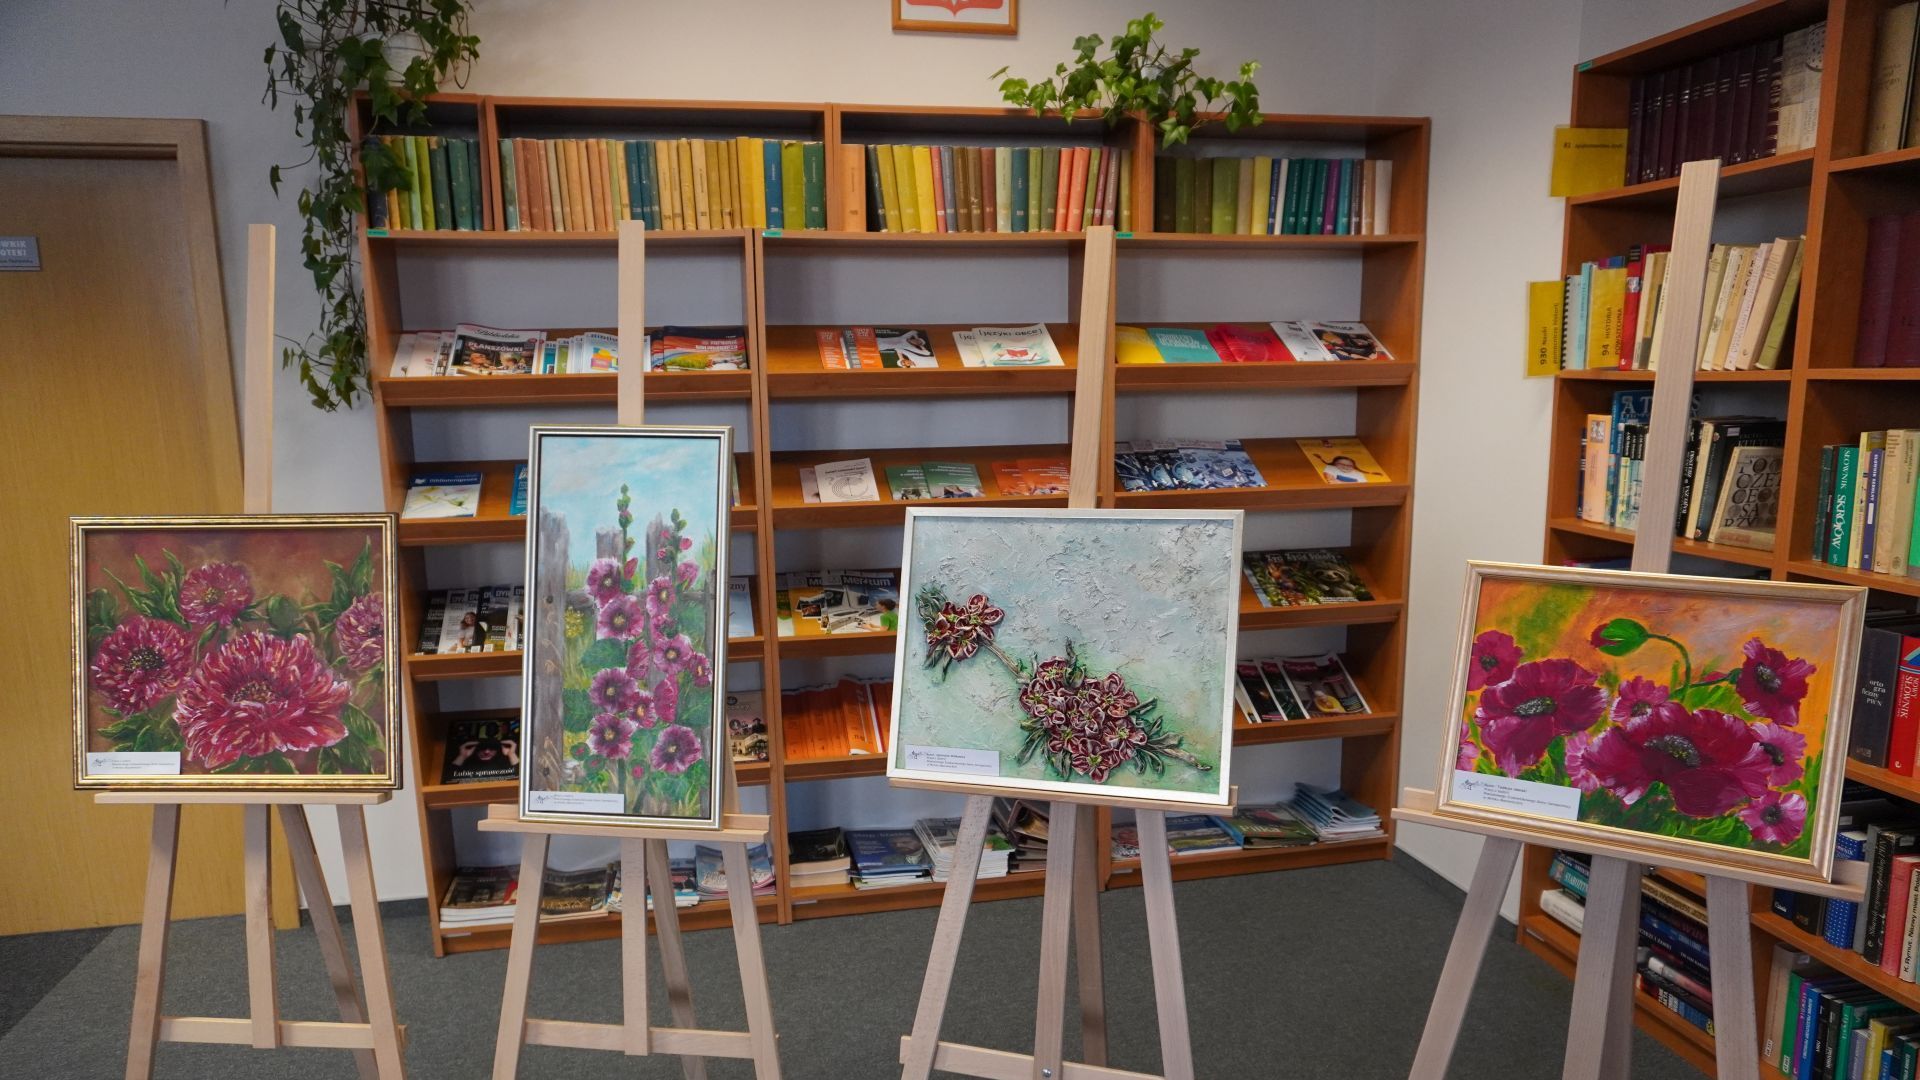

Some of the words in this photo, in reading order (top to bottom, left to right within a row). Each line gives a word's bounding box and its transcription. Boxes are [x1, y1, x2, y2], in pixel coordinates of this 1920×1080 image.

[1602, 343, 1610, 356] 94
[1840, 448, 1851, 489] SŁOWNIK
[1869, 680, 1884, 688] orto
[1867, 697, 1882, 707] PWN
[1900, 675, 1913, 719] SŁOWNIK
